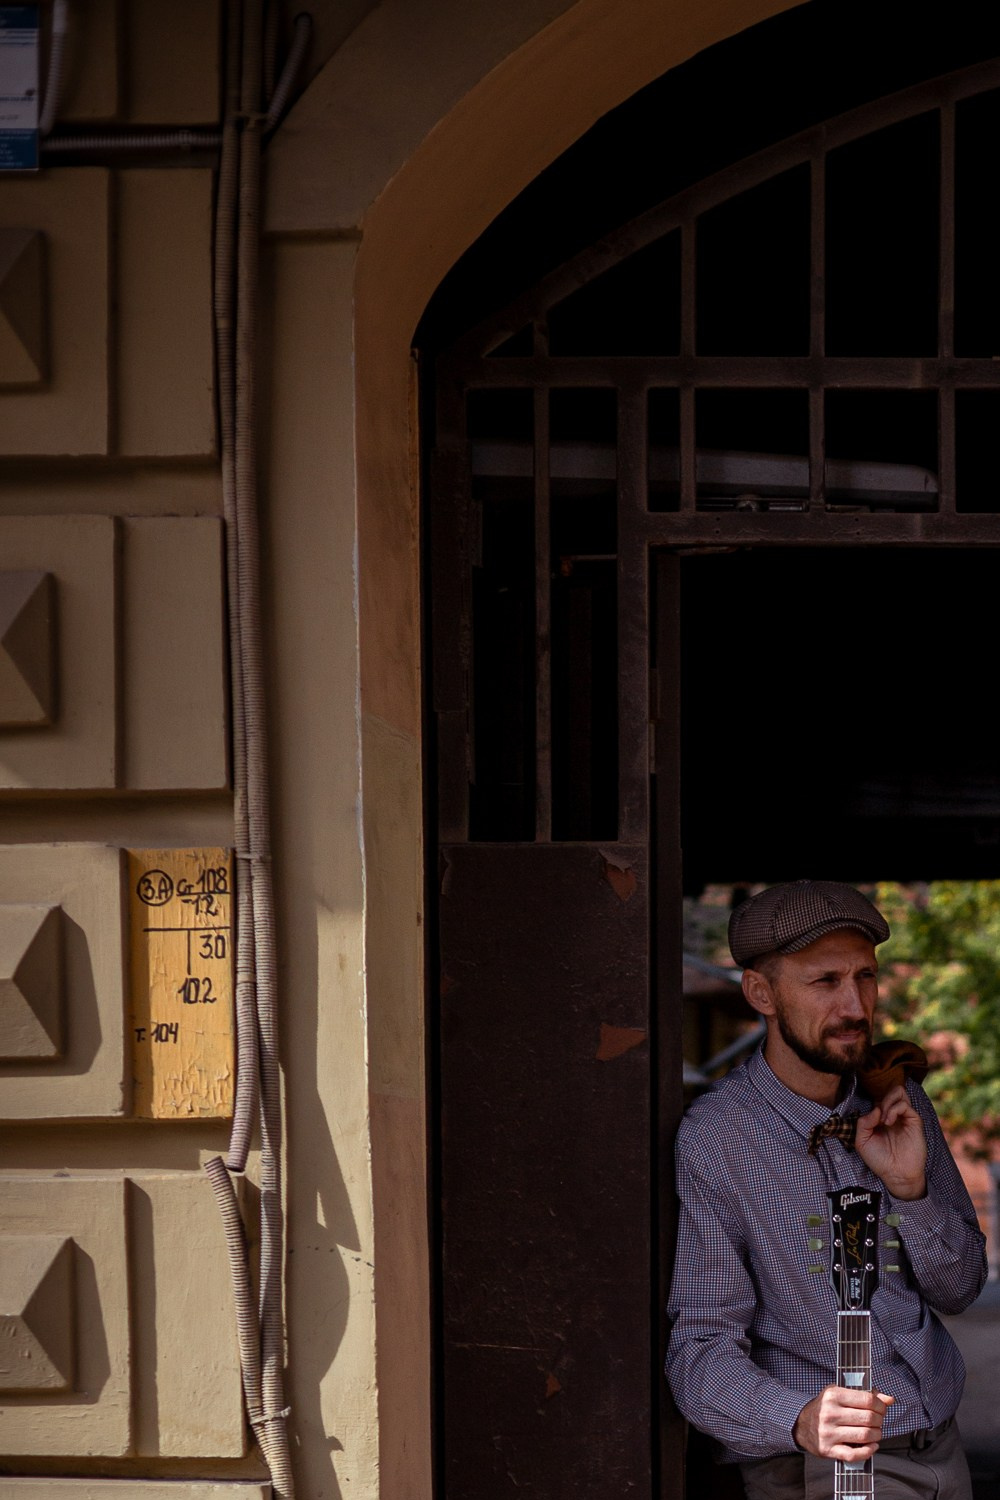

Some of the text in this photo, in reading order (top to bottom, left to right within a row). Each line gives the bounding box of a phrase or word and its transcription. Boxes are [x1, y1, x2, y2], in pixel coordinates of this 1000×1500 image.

[196, 866, 228, 894] 108
[150, 1022, 179, 1045] 104
[840, 1192, 872, 1211] Gibson
